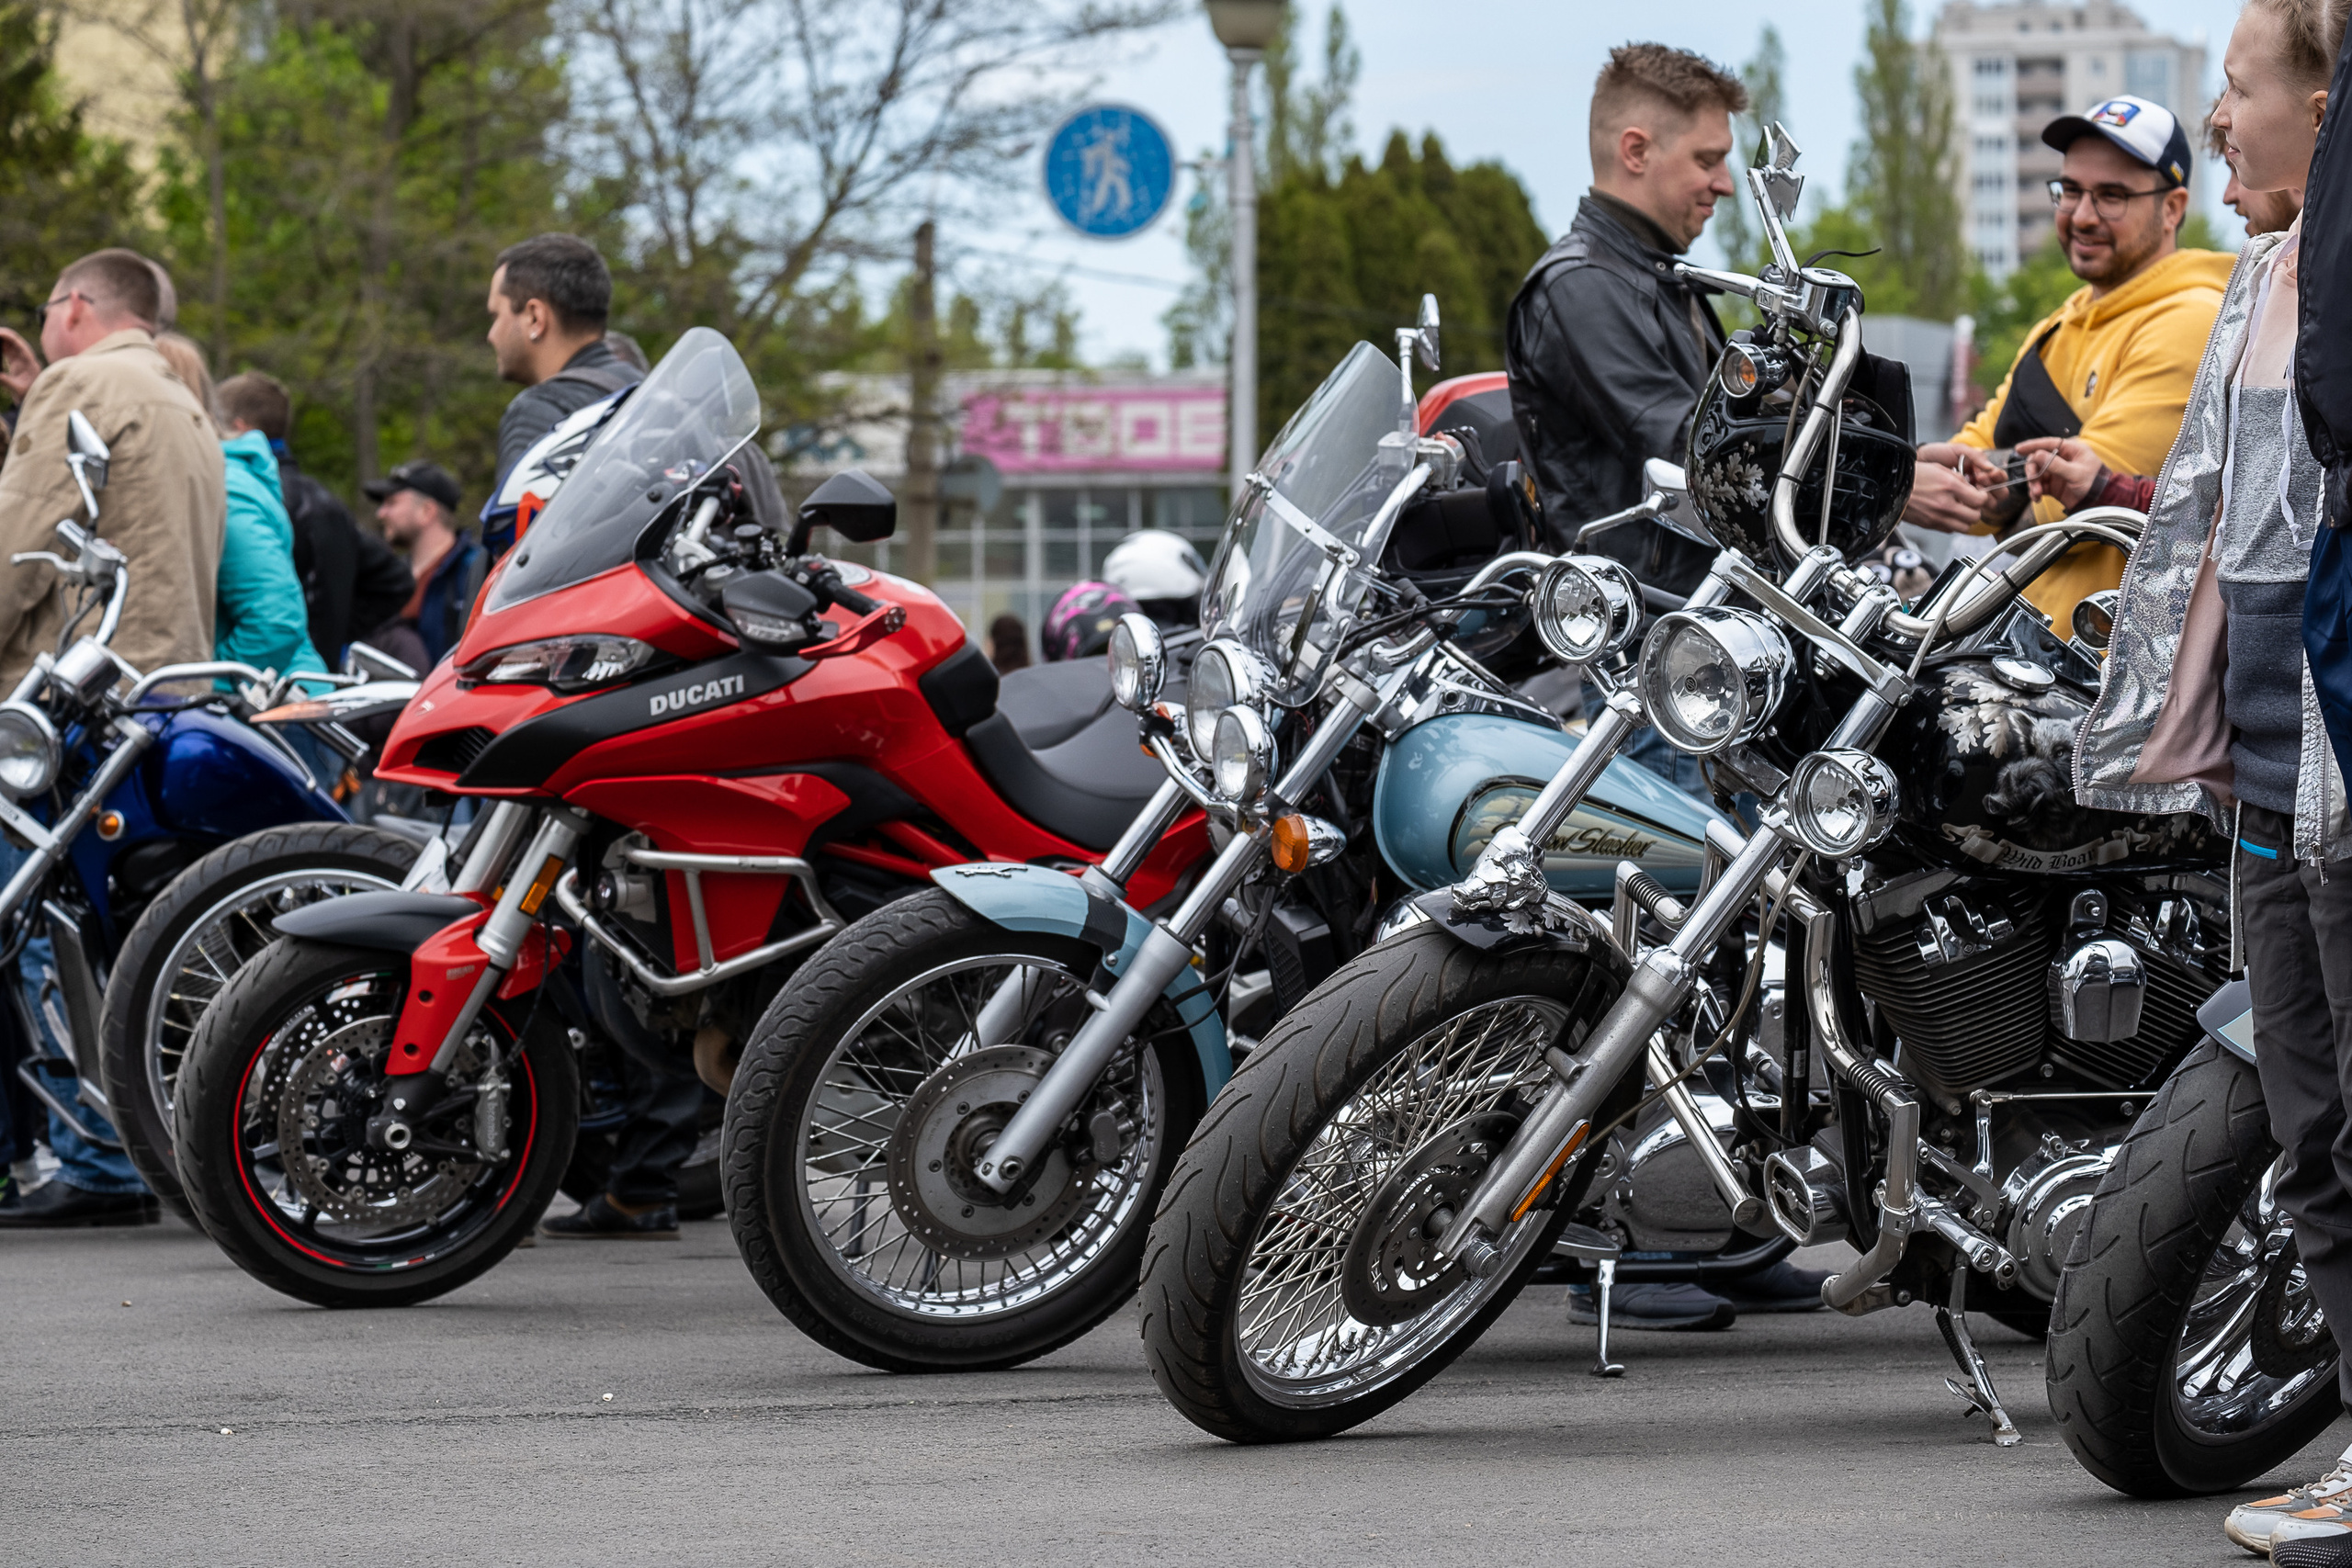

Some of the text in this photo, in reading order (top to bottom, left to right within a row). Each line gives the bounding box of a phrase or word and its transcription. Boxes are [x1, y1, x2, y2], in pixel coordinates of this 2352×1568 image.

[649, 673, 745, 716] DUCATI
[1568, 827, 1657, 859] Slasher
[1999, 845, 2096, 872] Wild Boar
[486, 1101, 501, 1148] brembo
